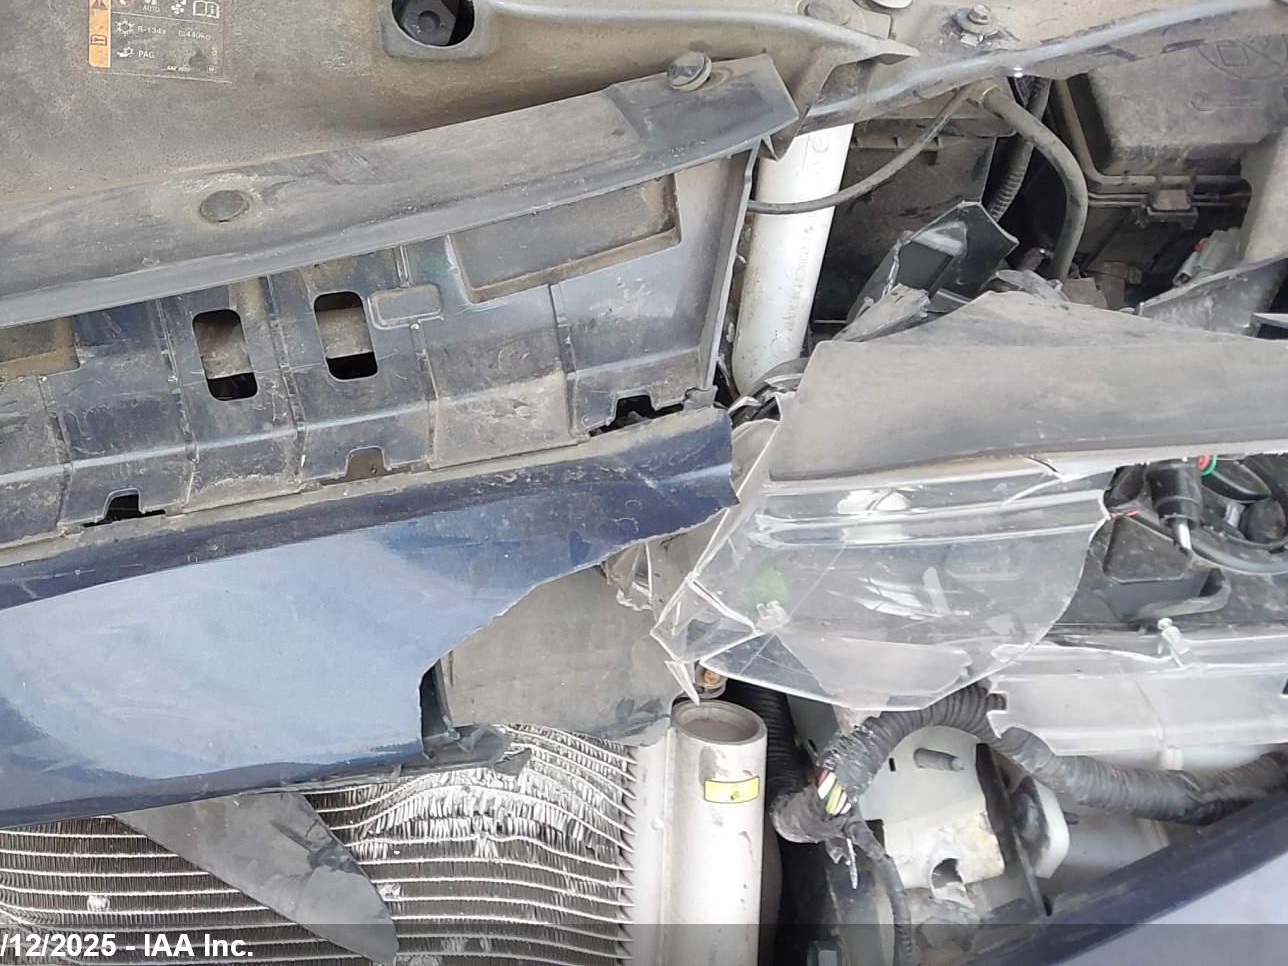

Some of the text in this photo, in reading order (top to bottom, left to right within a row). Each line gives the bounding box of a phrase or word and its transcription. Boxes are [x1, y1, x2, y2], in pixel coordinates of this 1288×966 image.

[142, 4, 161, 13] AUTO
[137, 26, 167, 35] R-134a
[138, 50, 155, 59] PAG
